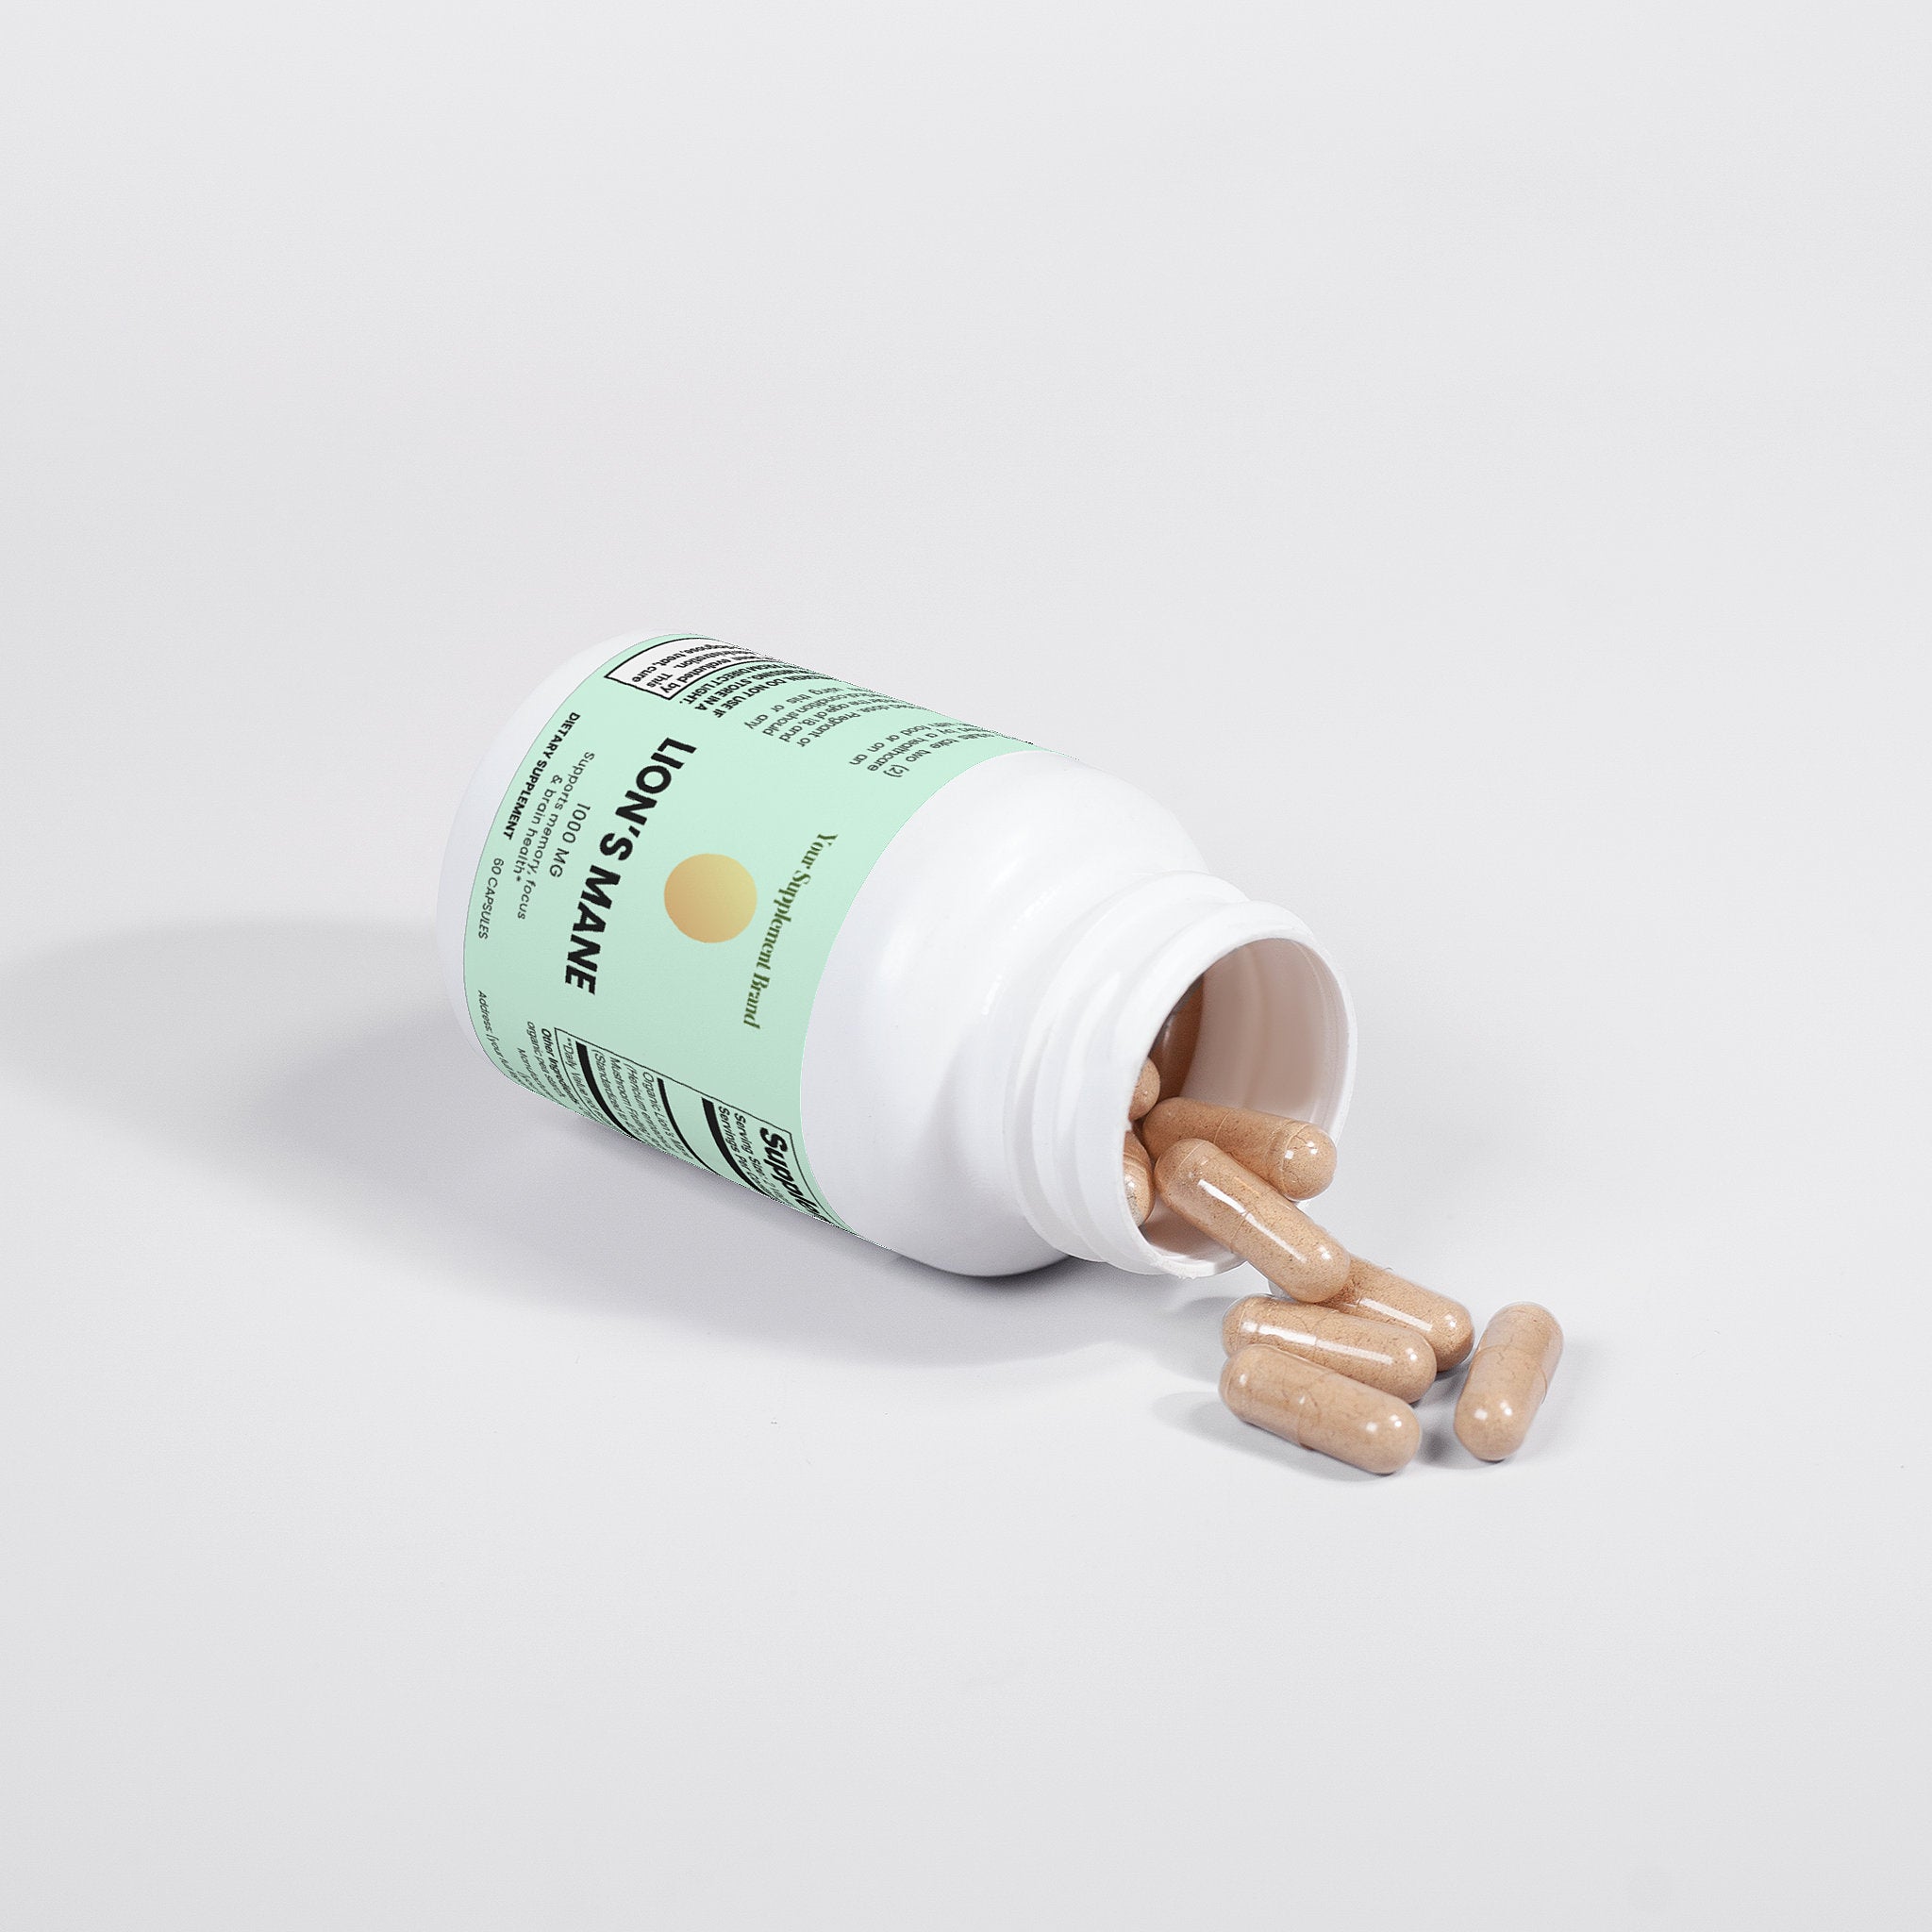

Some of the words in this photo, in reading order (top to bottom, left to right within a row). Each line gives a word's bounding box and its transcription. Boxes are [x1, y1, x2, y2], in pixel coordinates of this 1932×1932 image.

[651, 653, 687, 666] treat,
[631, 665, 658, 683] cure
[646, 673, 674, 688] This
[675, 658, 732, 685] evaluated
[710, 668, 752, 687] DIRECT
[659, 682, 681, 693] by
[713, 678, 753, 698] STORE
[741, 684, 770, 698] NOT
[765, 678, 788, 687] DO
[679, 683, 716, 705] LIGHT.
[703, 695, 721, 706] IN
[720, 695, 747, 710] USE
[785, 693, 812, 705] this
[794, 694, 848, 713] condition
[694, 703, 708, 711] A
[712, 708, 726, 719] IF
[770, 704, 785, 713] or
[812, 711, 828, 720] of
[824, 703, 850, 713] age
[743, 714, 769, 730] any
[761, 711, 800, 737] should
[797, 717, 821, 726] 18,
[807, 711, 861, 739] Pregnant
[899, 724, 932, 737] food
[542, 711, 581, 759] DIETARY
[778, 725, 803, 743] and
[796, 737, 811, 748] or
[885, 734, 900, 742] or
[929, 738, 959, 749] take
[866, 741, 886, 753] on
[867, 737, 929, 772] healthcare
[905, 749, 932, 762] two
[848, 754, 868, 765] an
[550, 774, 563, 785] &
[554, 751, 595, 810] Supports
[882, 764, 910, 778] (2)
[503, 759, 548, 841] SUPPLEMENT
[531, 788, 558, 824] brain
[599, 737, 697, 861] LION'S
[561, 803, 591, 843] 1000
[526, 813, 558, 875] memory,
[801, 834, 838, 870] Your
[491, 858, 505, 875] 60
[549, 847, 570, 878] MG
[477, 876, 498, 940] CAPSULES
[517, 879, 537, 920] focus
[564, 864, 622, 995] MANE
[756, 870, 811, 971] Supplement
[742, 972, 771, 1029] Brand
[477, 990, 493, 1034] Address:
[525, 1021, 543, 1058] organic
[534, 1055, 550, 1074] pea
[541, 1027, 555, 1058] Other
[547, 1057, 580, 1105] Ingredients:
[571, 1072, 589, 1096] Value
[591, 1049, 625, 1114] (Standardized
[609, 1057, 632, 1108] Mushroom
[623, 1062, 648, 1112] (Hericium
[641, 1071, 662, 1112] Organic
[654, 1110, 675, 1139] Lion's
[718, 1106, 741, 1154] Servings
[734, 1153, 752, 1172] Per
[734, 1112, 755, 1156] Serving
